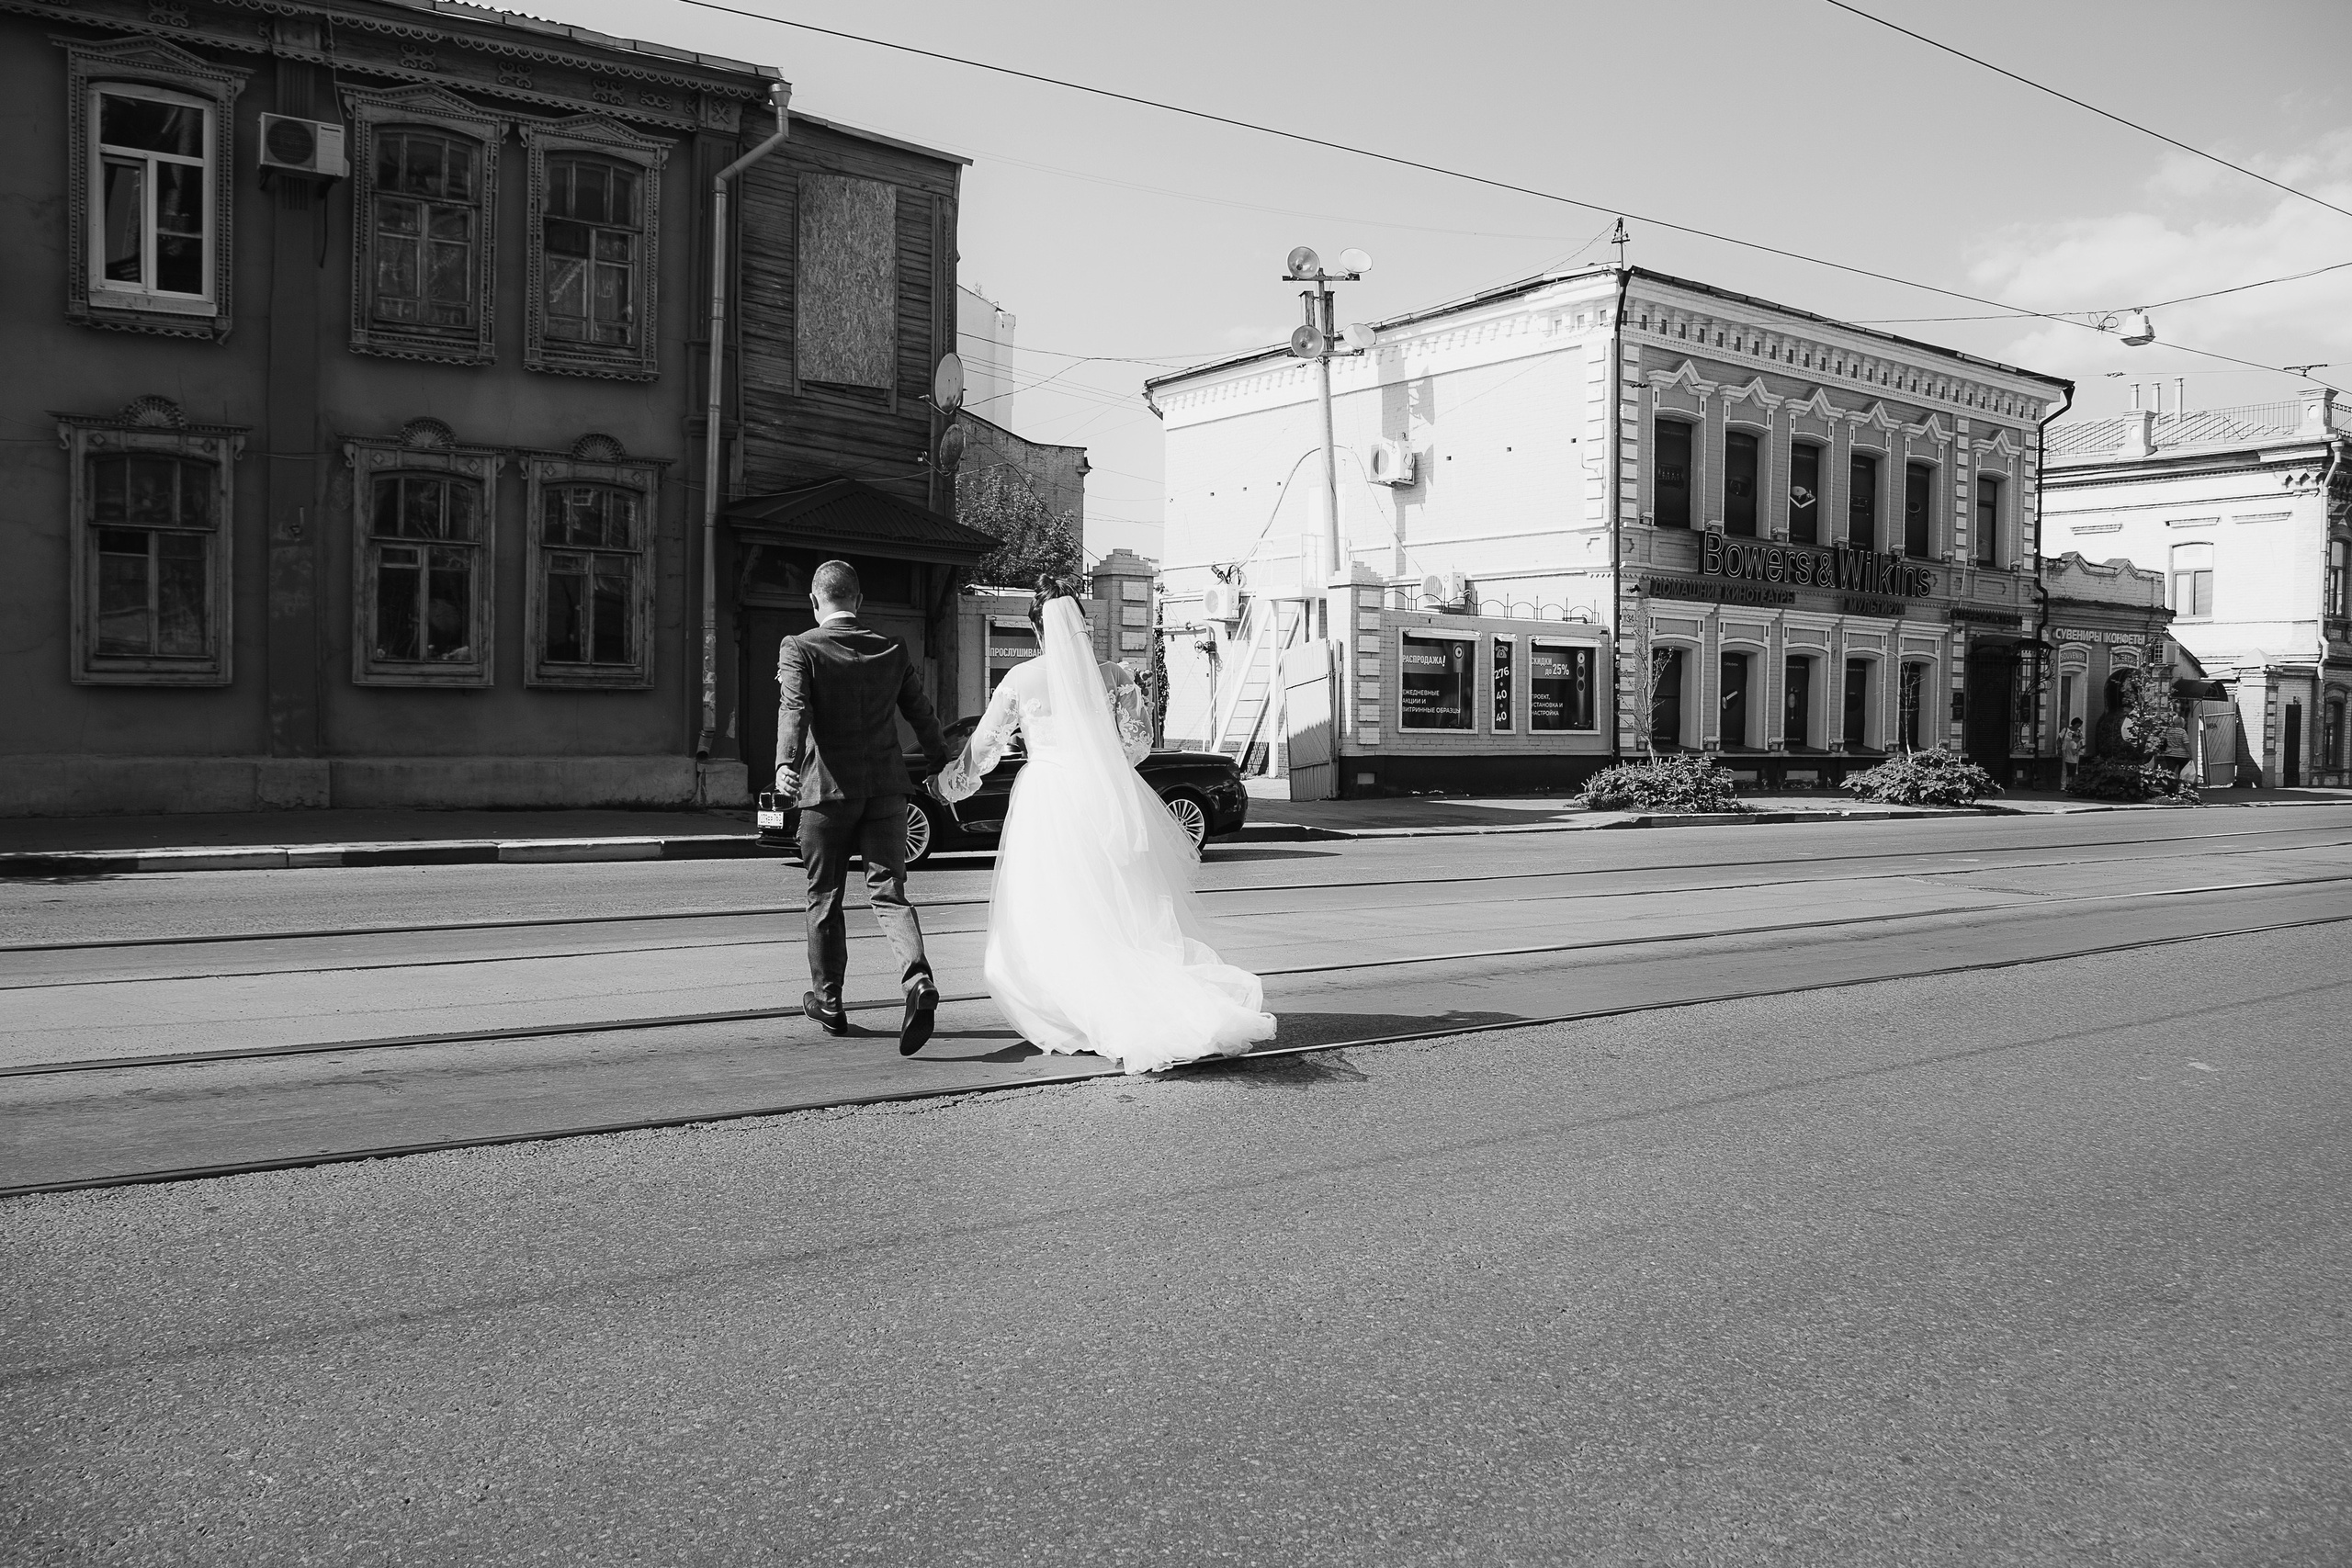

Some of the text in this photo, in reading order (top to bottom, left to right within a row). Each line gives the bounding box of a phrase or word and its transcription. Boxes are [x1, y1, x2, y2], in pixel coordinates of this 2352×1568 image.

[1703, 530, 1930, 598] Bowers & Wilkins
[1655, 581, 1722, 599] ДОМАШНИ
[1849, 597, 1905, 615] МУЛЬТИРУМ
[2055, 627, 2145, 645] СУВЕНИРЫ КОНФЕТЫ
[989, 648, 1043, 658] ПРОСЛУШИВАН
[1402, 654, 1446, 668] РАСПРОДАЖА!
[1532, 657, 1553, 667] СКИДКИ
[1494, 666, 1510, 680] 276
[1544, 663, 1570, 676] до 25%
[1496, 689, 1508, 700] 40
[1436, 706, 1461, 715] ОБРАЗЦЫ
[1496, 711, 1507, 722] 40
